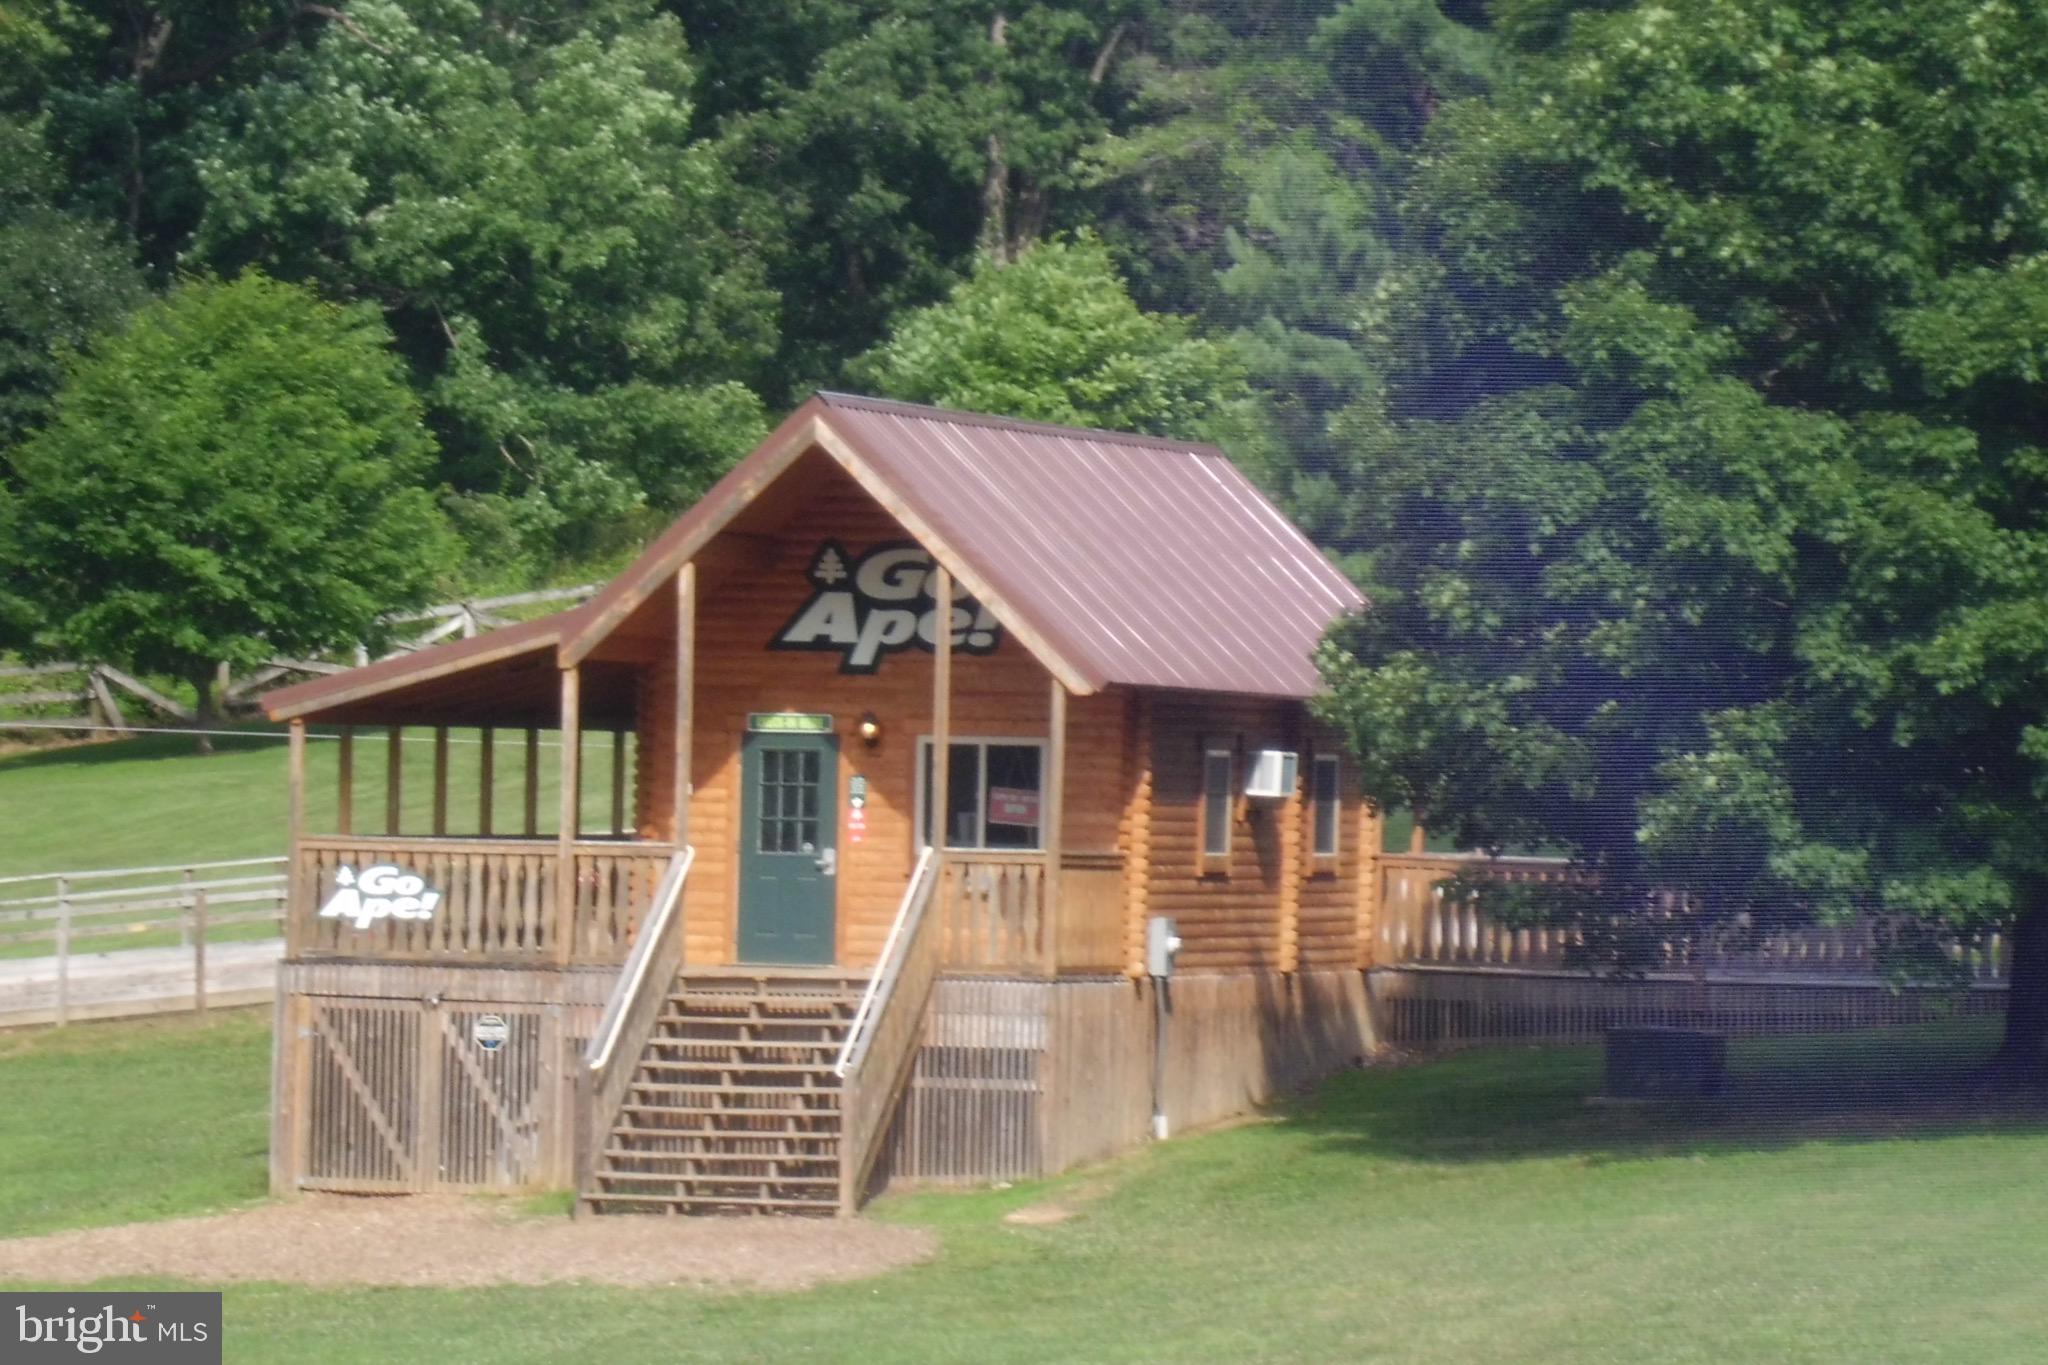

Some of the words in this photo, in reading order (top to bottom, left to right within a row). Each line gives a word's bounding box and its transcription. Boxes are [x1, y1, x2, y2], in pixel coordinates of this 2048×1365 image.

[781, 591, 1001, 665] Ape!
[358, 866, 425, 895] Go
[319, 888, 441, 929] Ape!
